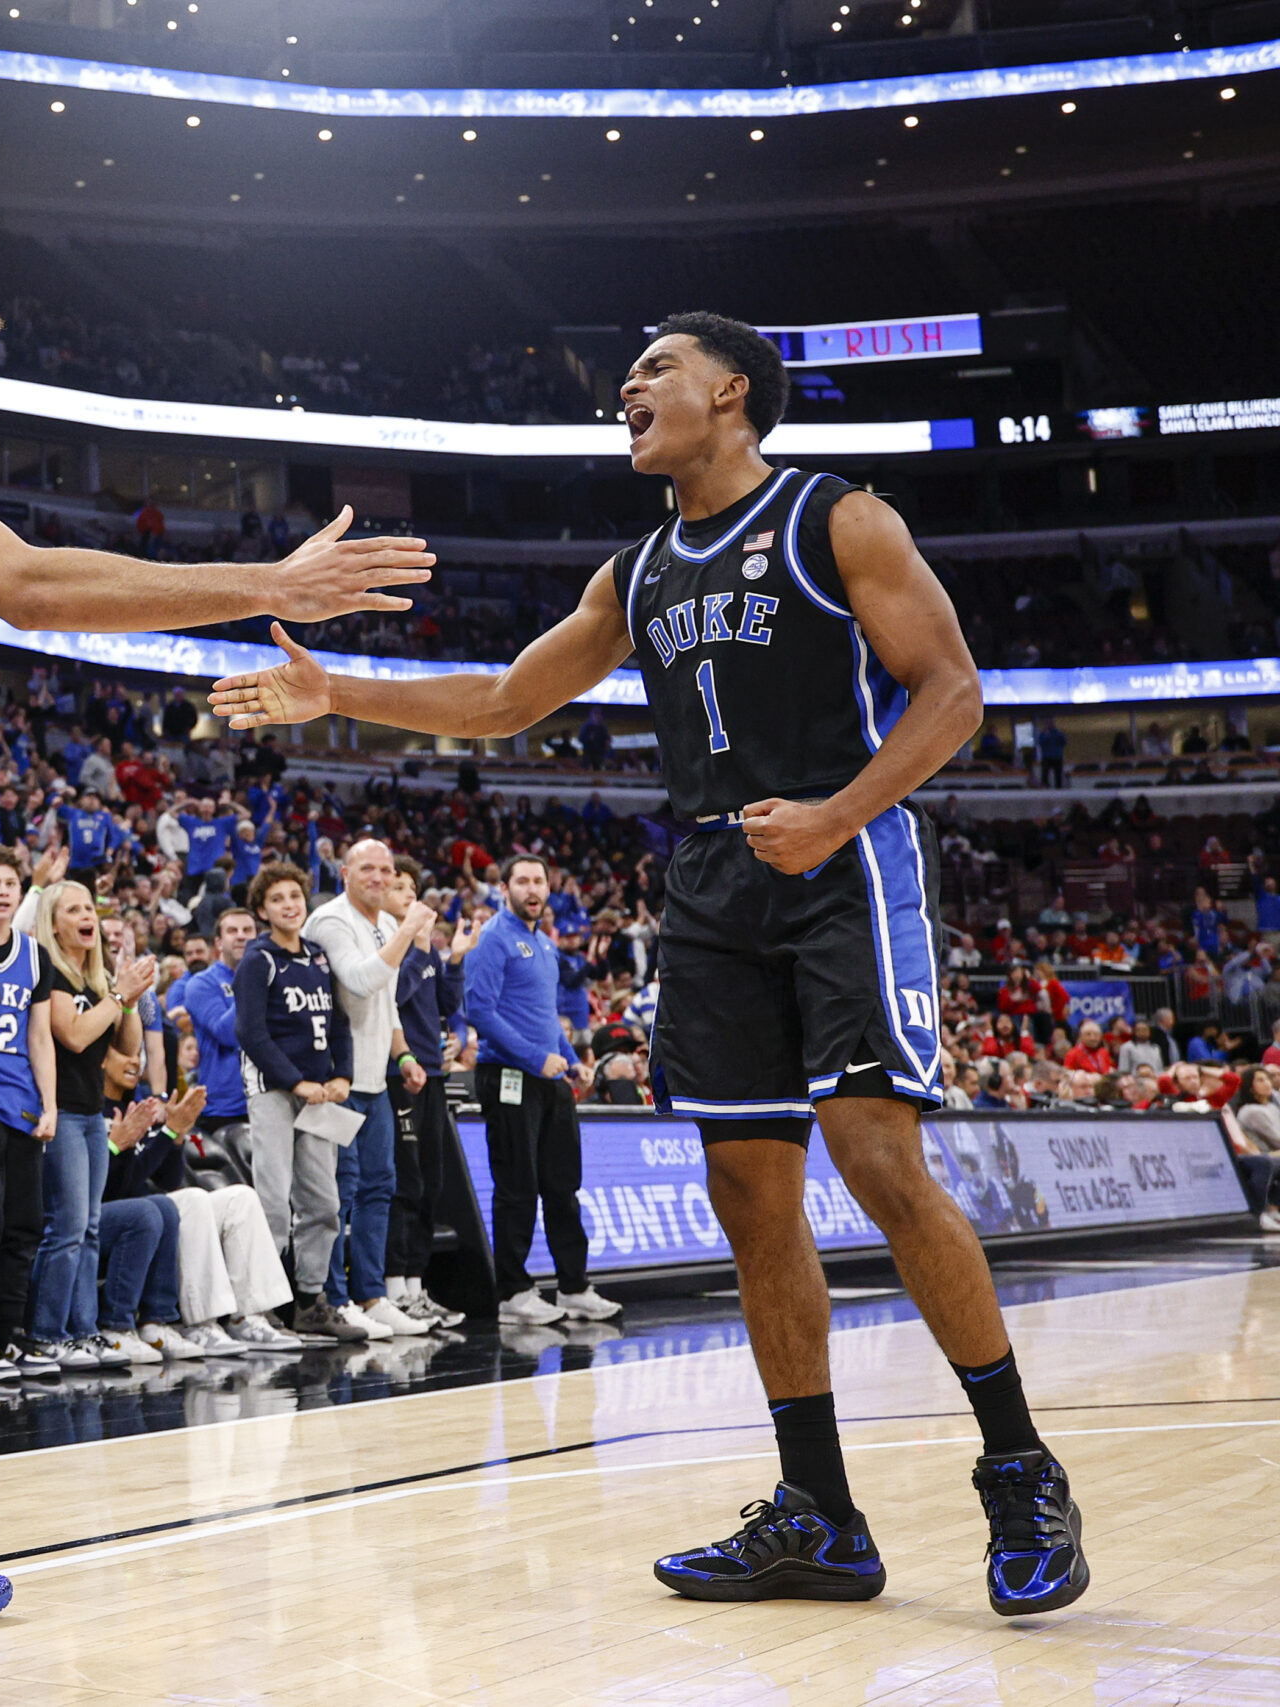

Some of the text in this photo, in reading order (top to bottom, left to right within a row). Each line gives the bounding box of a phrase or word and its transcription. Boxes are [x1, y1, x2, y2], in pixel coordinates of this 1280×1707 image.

[846, 322, 942, 358] RUSH
[1158, 405, 1191, 420] SAINT
[1193, 402, 1226, 418] LOUIS
[1159, 418, 1197, 434] SANTA
[646, 591, 780, 669] DUKE
[695, 658, 731, 755] 1
[283, 986, 333, 1014] Duk
[899, 988, 934, 1032] D
[311, 1015, 328, 1051] 5
[1047, 1135, 1114, 1170] SUNDAY
[682, 1182, 729, 1248] O
